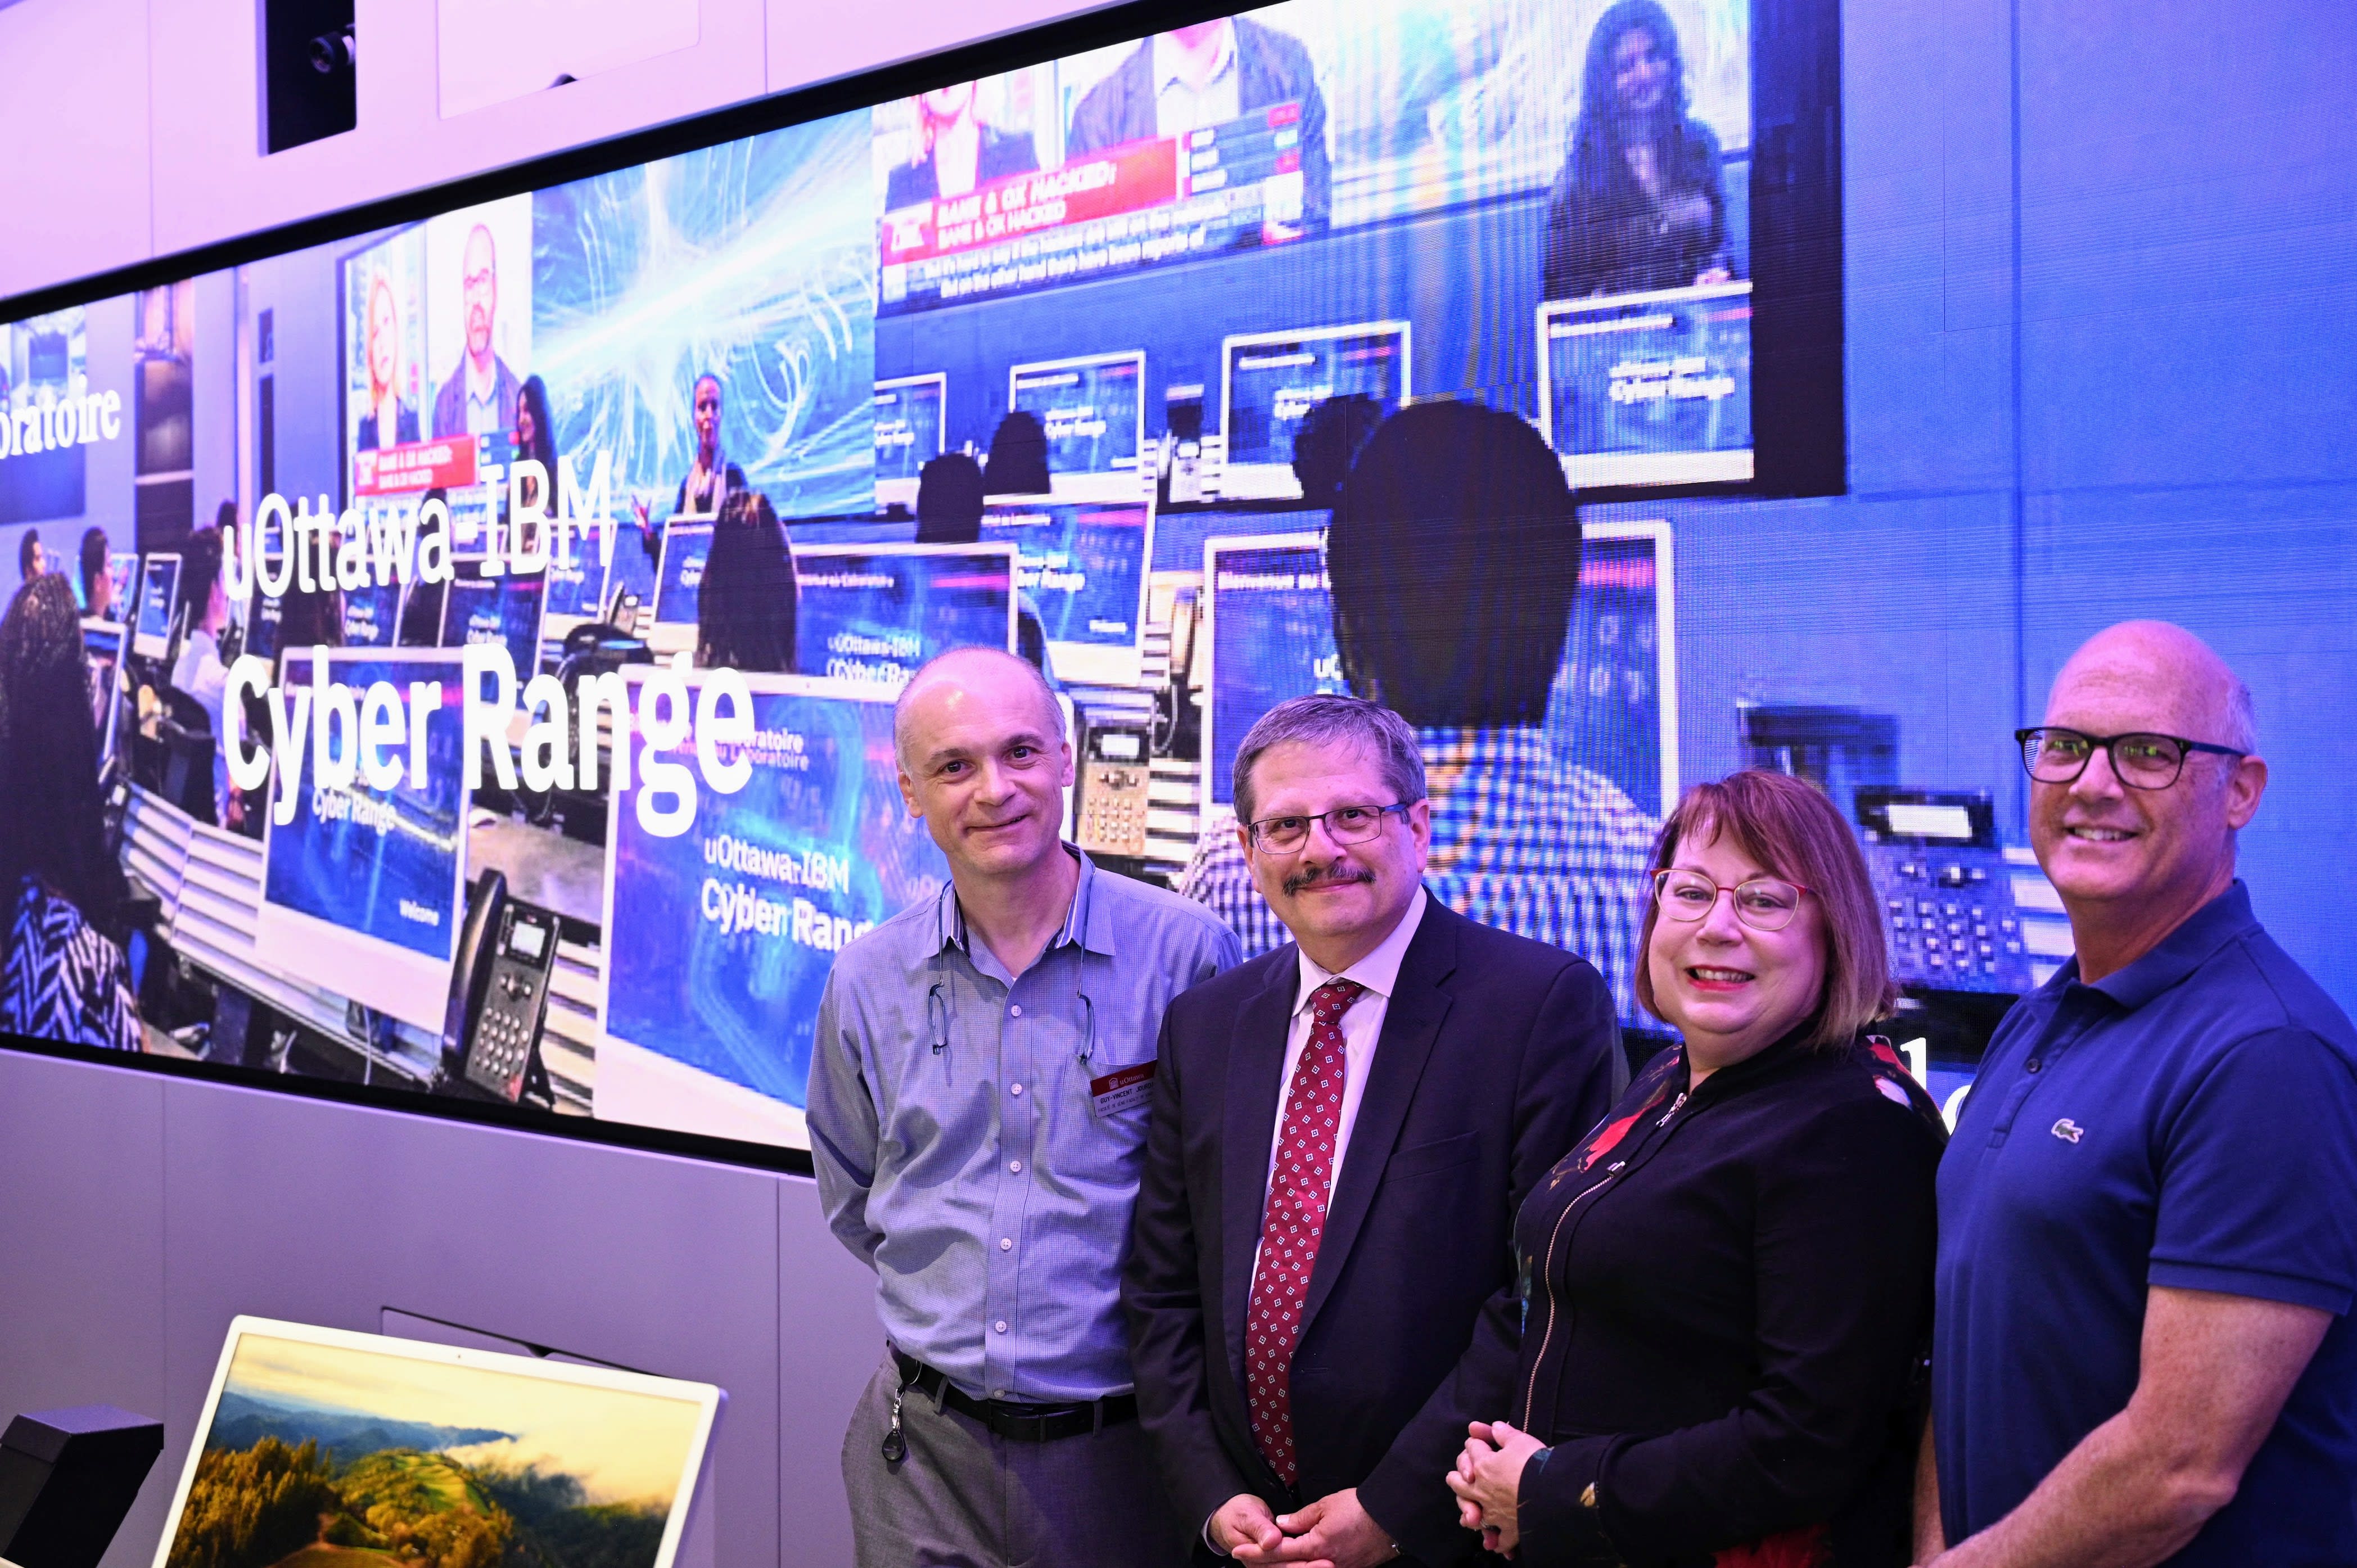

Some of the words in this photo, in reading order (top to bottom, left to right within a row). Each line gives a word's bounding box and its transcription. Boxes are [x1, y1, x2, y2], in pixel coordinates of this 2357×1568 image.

[223, 450, 611, 600] uOttawa-IBM
[223, 644, 441, 825] Cyber
[463, 643, 755, 837] Range
[312, 787, 351, 824] Cyber
[705, 834, 849, 894] uOttawa-IBM
[701, 878, 788, 934] Cyber
[1100, 1088, 1133, 1104] GUY-VINCENT
[1136, 1081, 1154, 1092] JOURD
[1119, 1073, 1145, 1085] uOttawa
